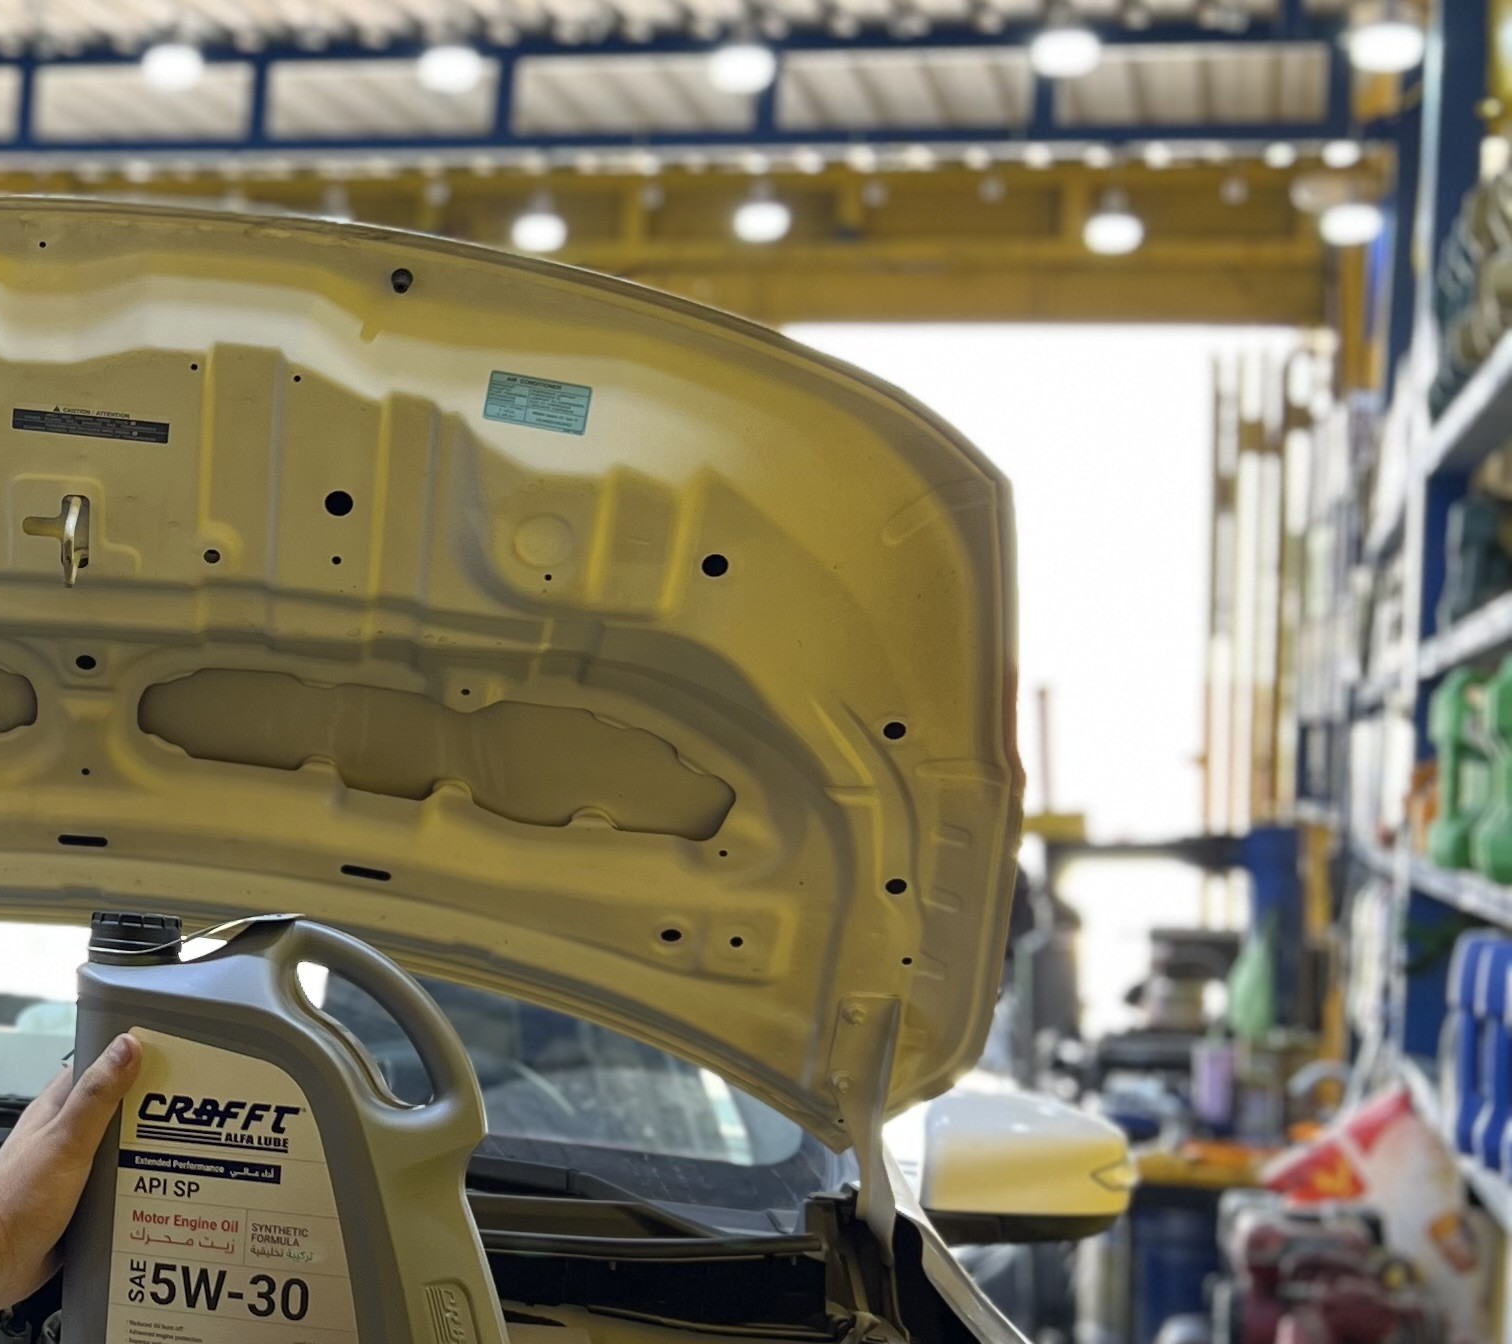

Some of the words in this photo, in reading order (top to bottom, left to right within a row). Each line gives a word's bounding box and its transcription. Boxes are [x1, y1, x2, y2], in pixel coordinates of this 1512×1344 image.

[138, 1092, 300, 1134] CRAFFT
[224, 1132, 255, 1145] ALFA
[257, 1135, 289, 1149] LUBE
[134, 1156, 172, 1168] Extended
[172, 1159, 225, 1174] Performance
[134, 1176, 167, 1196] API
[173, 1180, 200, 1199] SP
[132, 1210, 170, 1225] Motor
[174, 1214, 218, 1231] Engine
[221, 1220, 239, 1233] Oil
[251, 1222, 309, 1238] SYNTHETIC
[250, 1233, 300, 1247] FORMULA
[128, 1259, 146, 1303] SAE
[150, 1261, 309, 1322] 5W-30
